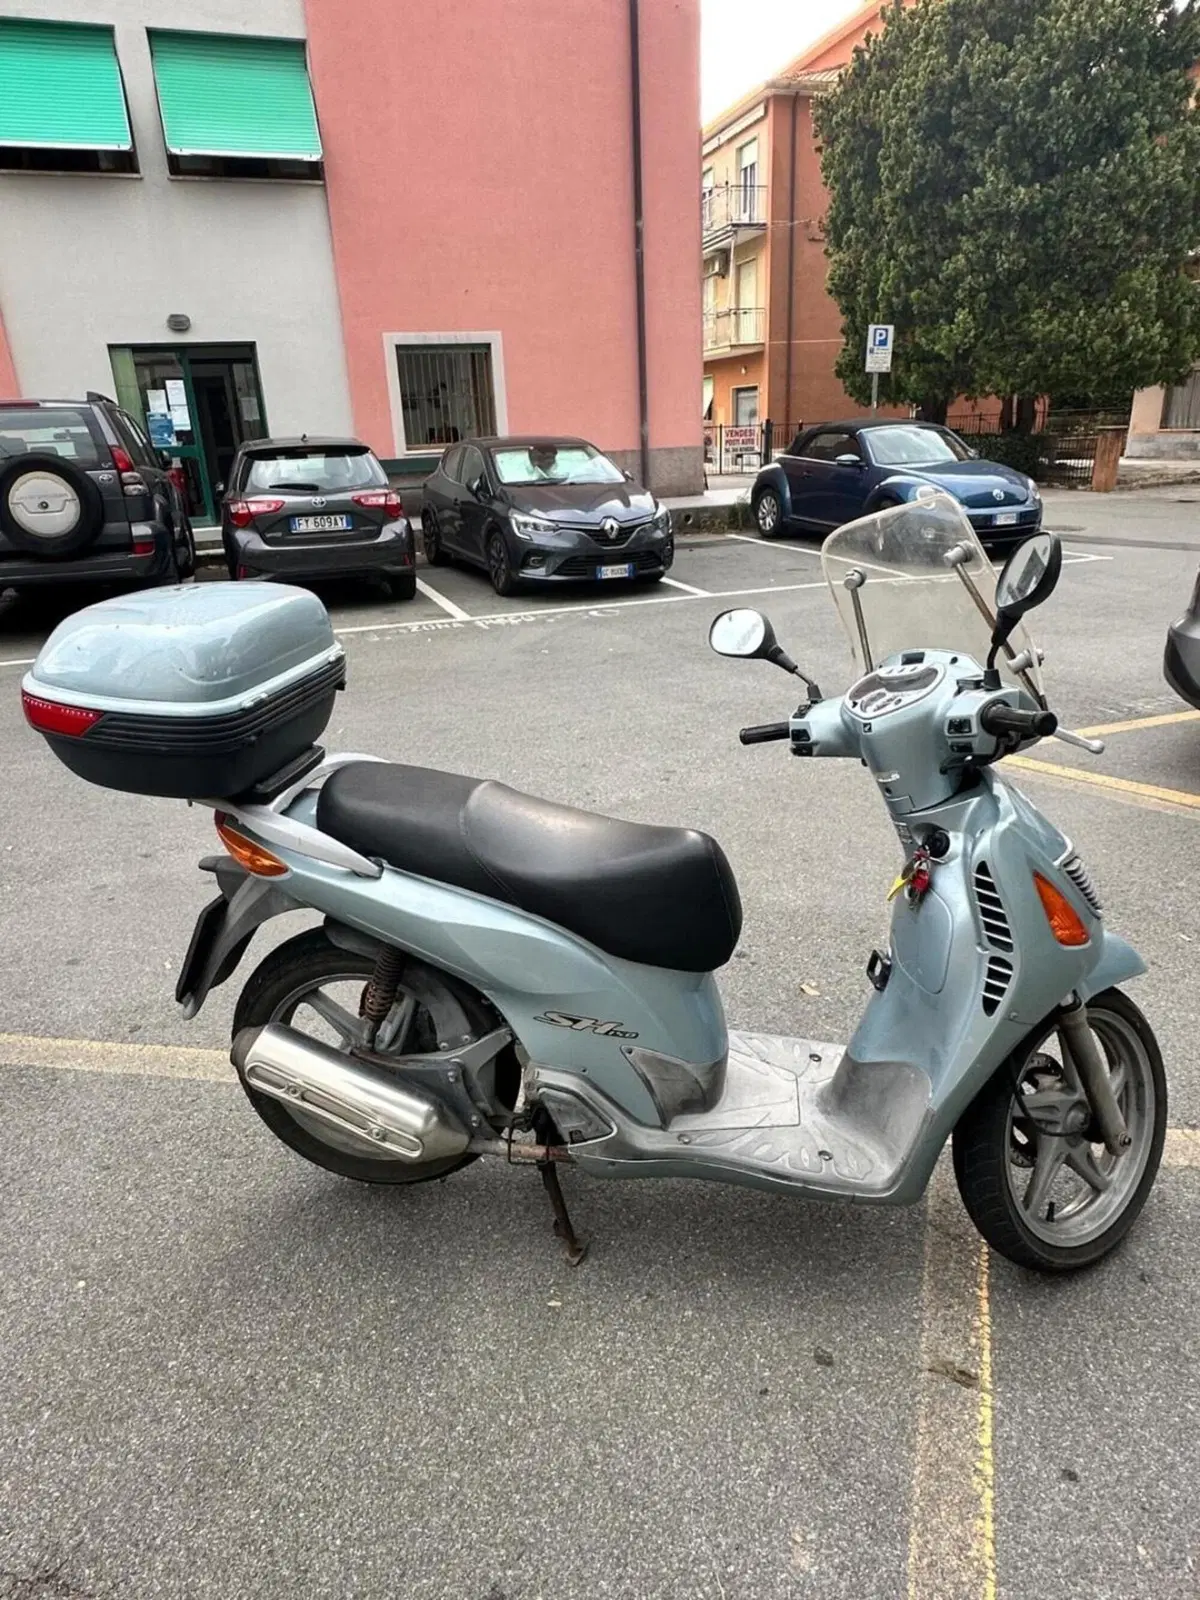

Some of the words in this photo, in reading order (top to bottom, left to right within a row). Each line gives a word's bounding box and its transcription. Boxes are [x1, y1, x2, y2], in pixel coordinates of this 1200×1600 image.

[875, 329, 887, 346] P
[724, 429, 755, 437] VENDESI
[297, 517, 311, 530] FY
[313, 515, 345, 528] 609AY
